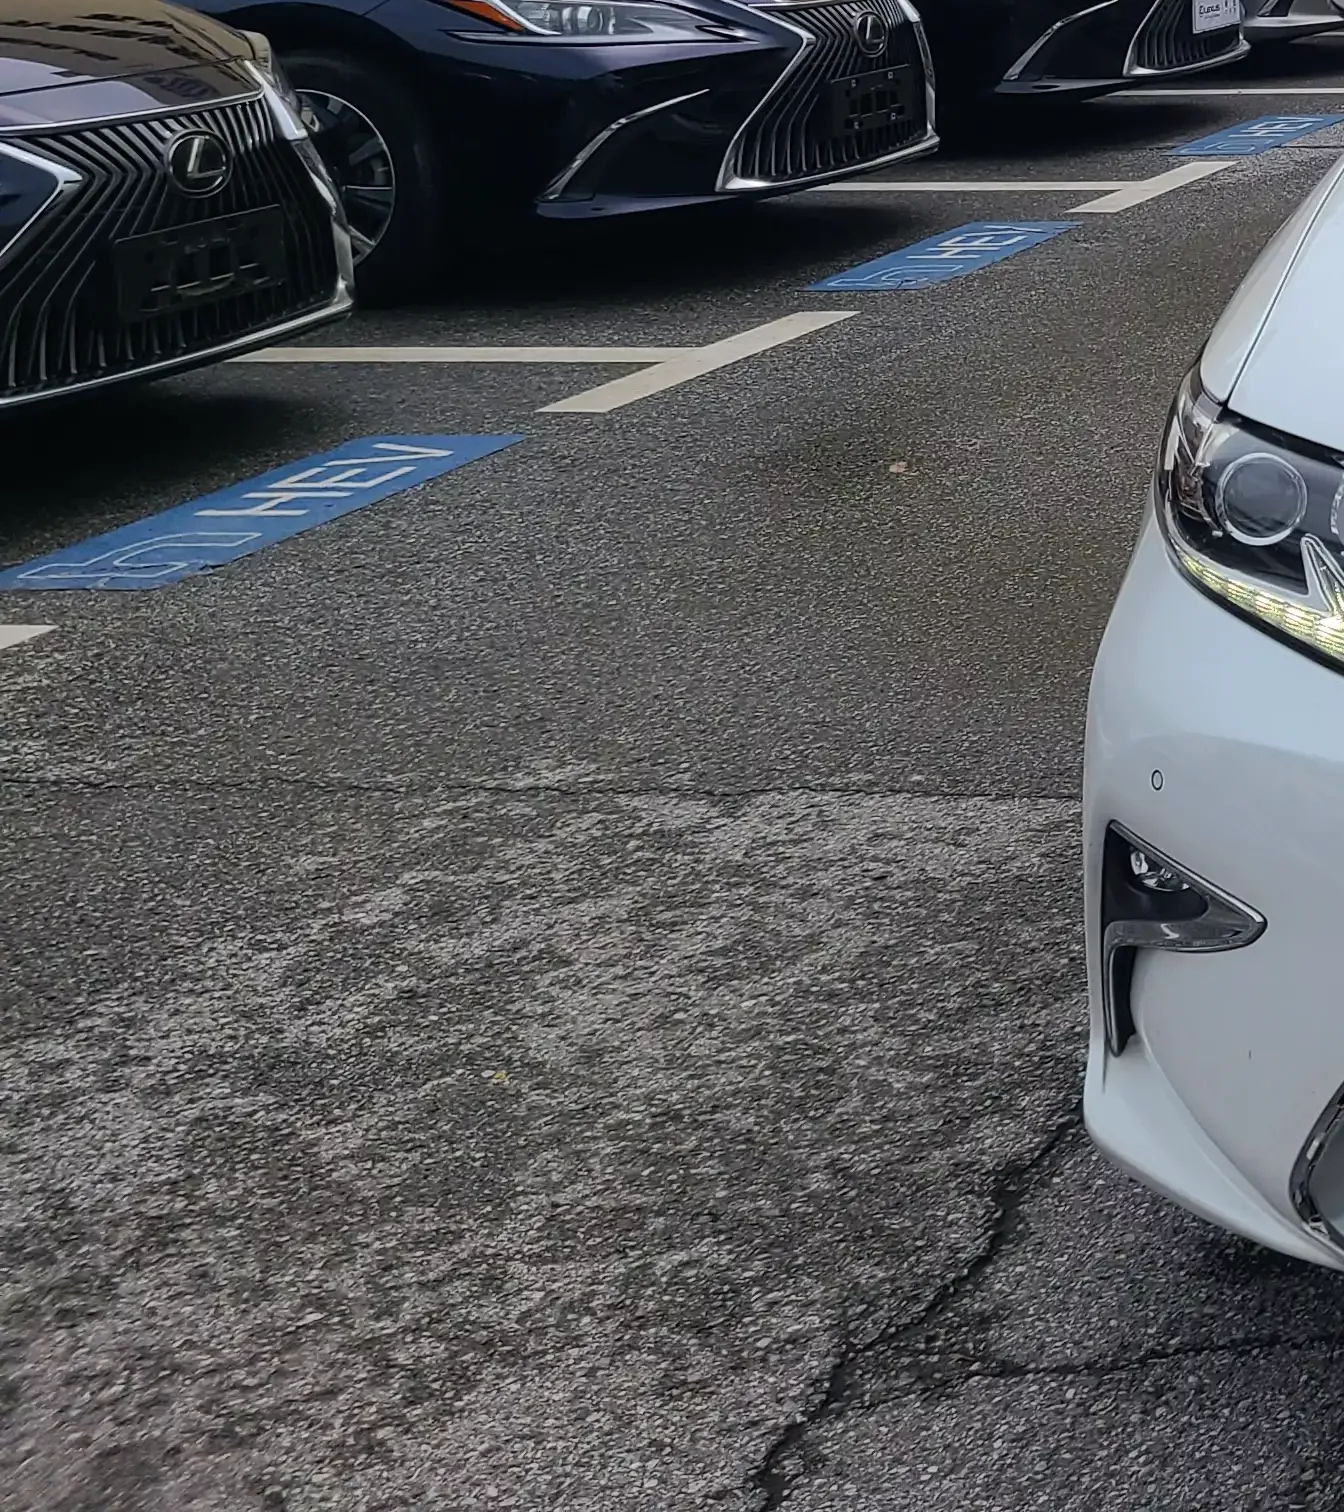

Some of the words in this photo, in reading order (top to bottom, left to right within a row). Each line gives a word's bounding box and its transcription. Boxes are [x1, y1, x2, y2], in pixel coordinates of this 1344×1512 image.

[1228, 116, 1325, 137] HEV
[905, 225, 1046, 259] HEV
[193, 442, 455, 517] HEV
